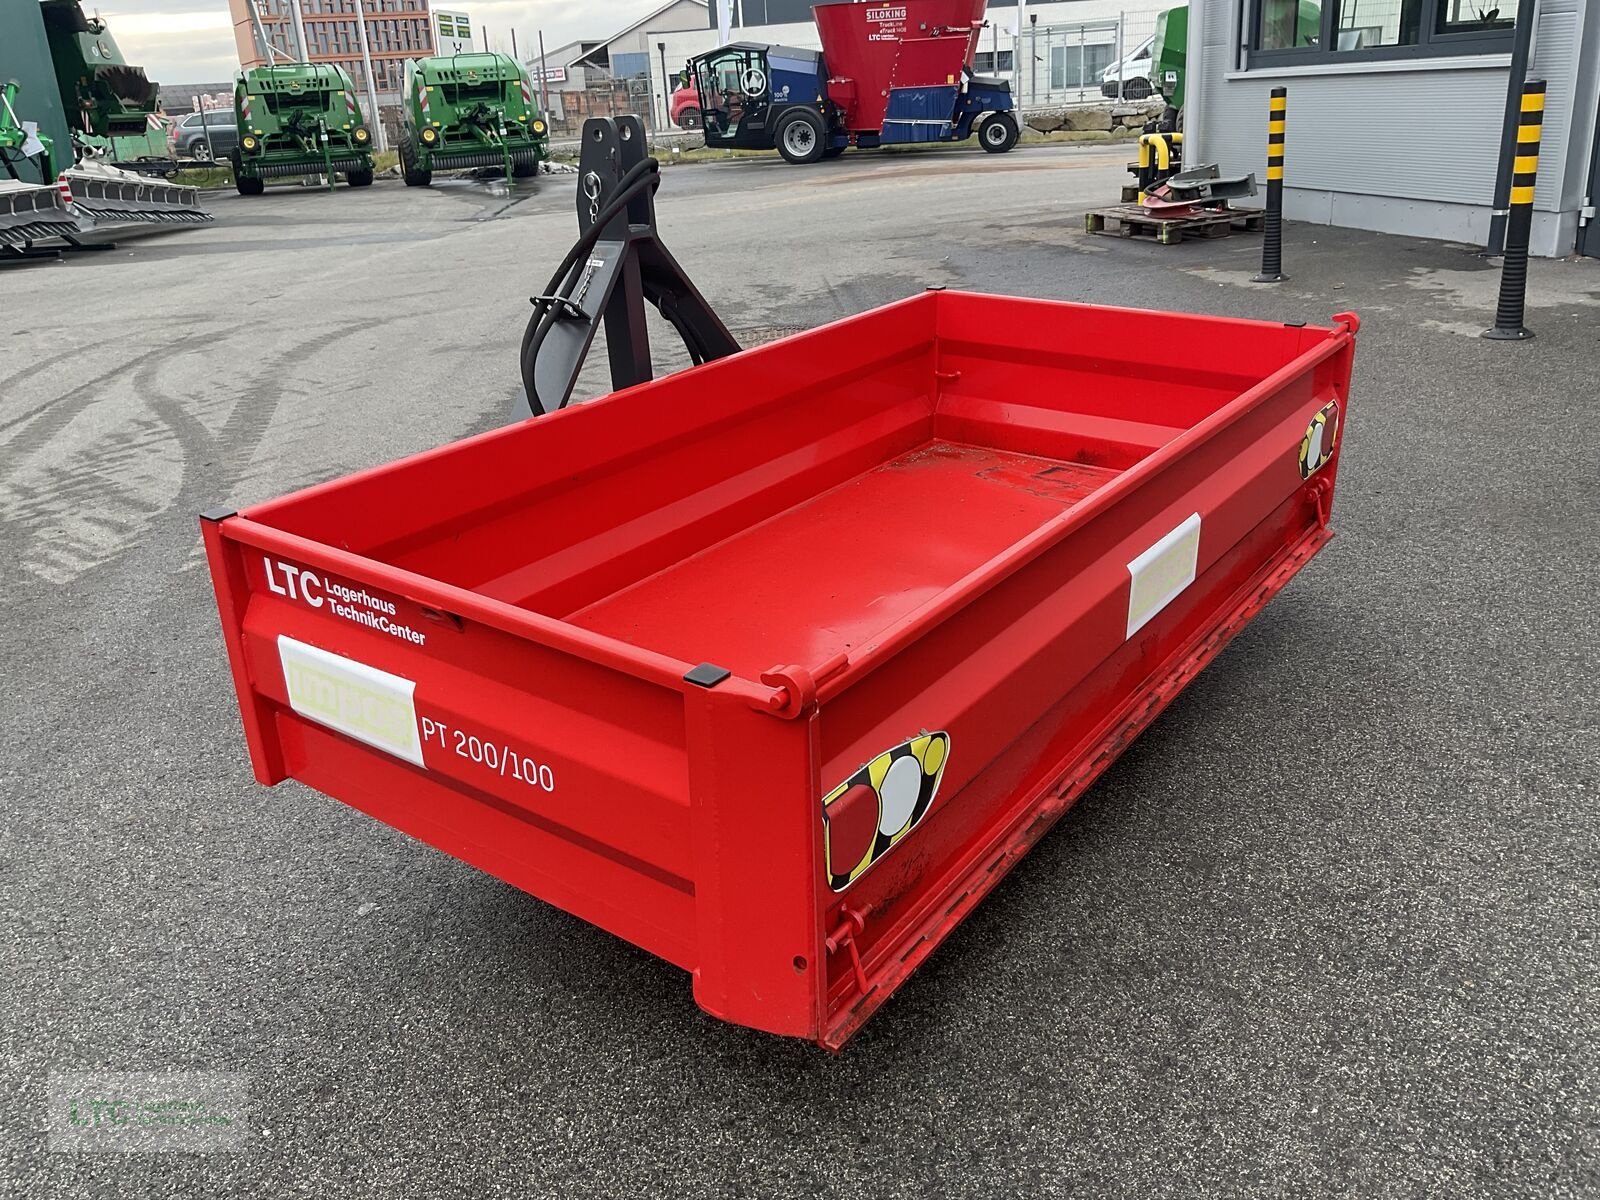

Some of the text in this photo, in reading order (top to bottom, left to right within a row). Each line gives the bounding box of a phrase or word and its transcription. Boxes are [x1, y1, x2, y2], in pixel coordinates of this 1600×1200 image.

[866, 9, 906, 19] SILOKING
[263, 557, 396, 615] LTC Lagerhaus
[328, 598, 426, 645] TechnikCenter
[422, 716, 555, 792] PT 200/100
